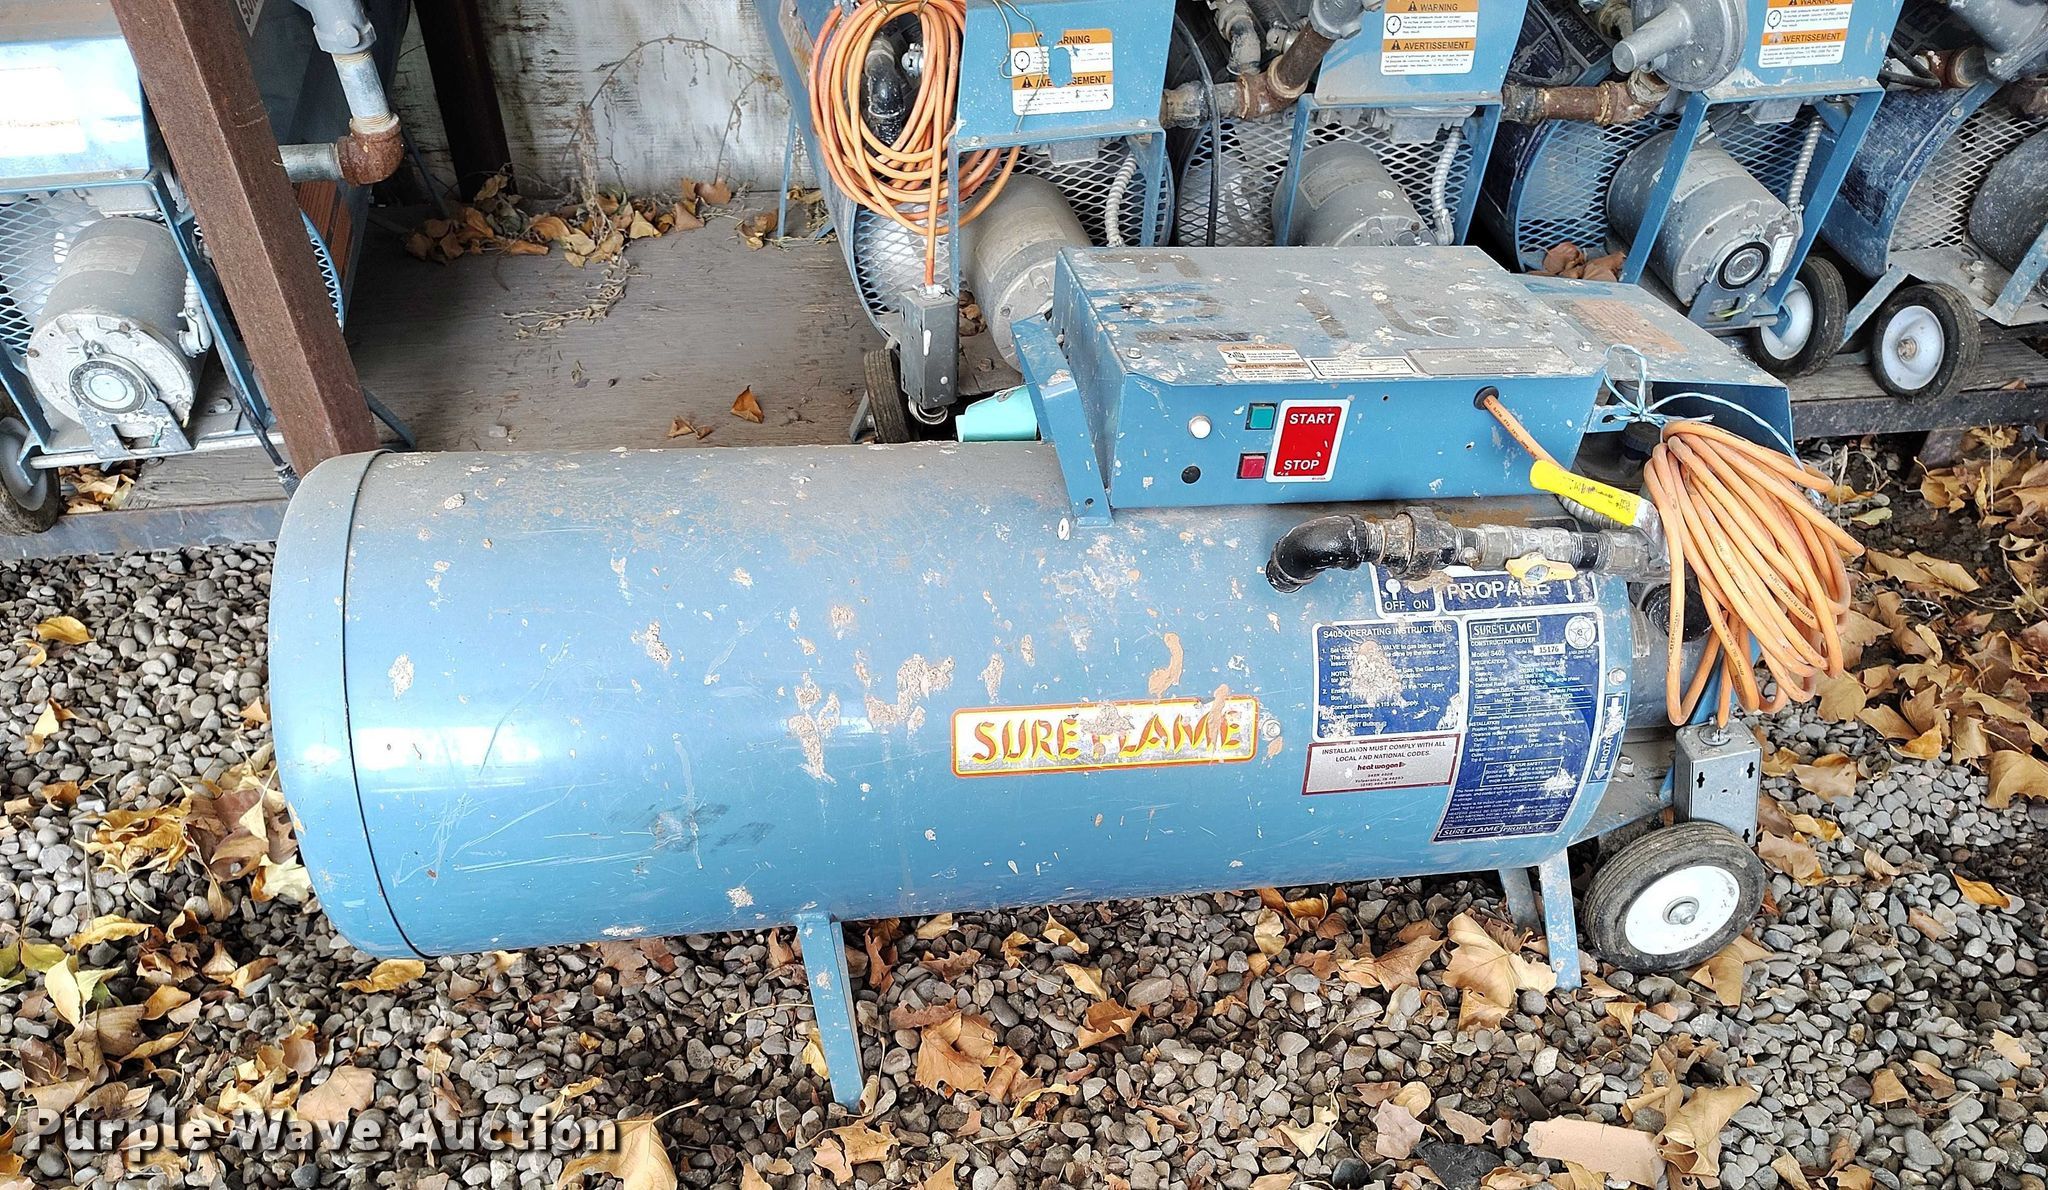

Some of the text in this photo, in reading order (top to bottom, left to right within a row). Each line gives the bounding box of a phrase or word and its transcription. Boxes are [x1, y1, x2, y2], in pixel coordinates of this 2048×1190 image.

[1420, 3, 1458, 11] WARNING
[1782, 32, 1841, 42] AVERTISSEMENT
[1404, 41, 1469, 50] AVERTISSEMENT
[1290, 413, 1335, 424] START
[1283, 460, 1319, 470] STOP
[1385, 600, 1430, 610] OFF ON
[1323, 624, 1453, 639] S405 OPERATING INSTRUCTIONS
[1473, 621, 1533, 636] SURE FLAME
[1539, 645, 1559, 653] 15176
[972, 717, 1080, 766] SURE
[1369, 744, 1388, 752] MUST
[1388, 742, 1416, 751] COMPLY
[1416, 741, 1434, 749] WITH
[1434, 740, 1447, 748] ALL
[1335, 750, 1432, 763] LOCAL AND NATIONAL CODES.
[1374, 762, 1399, 771] wagon
[1443, 828, 1466, 837] SURE
[1467, 825, 1501, 834] FLAME
